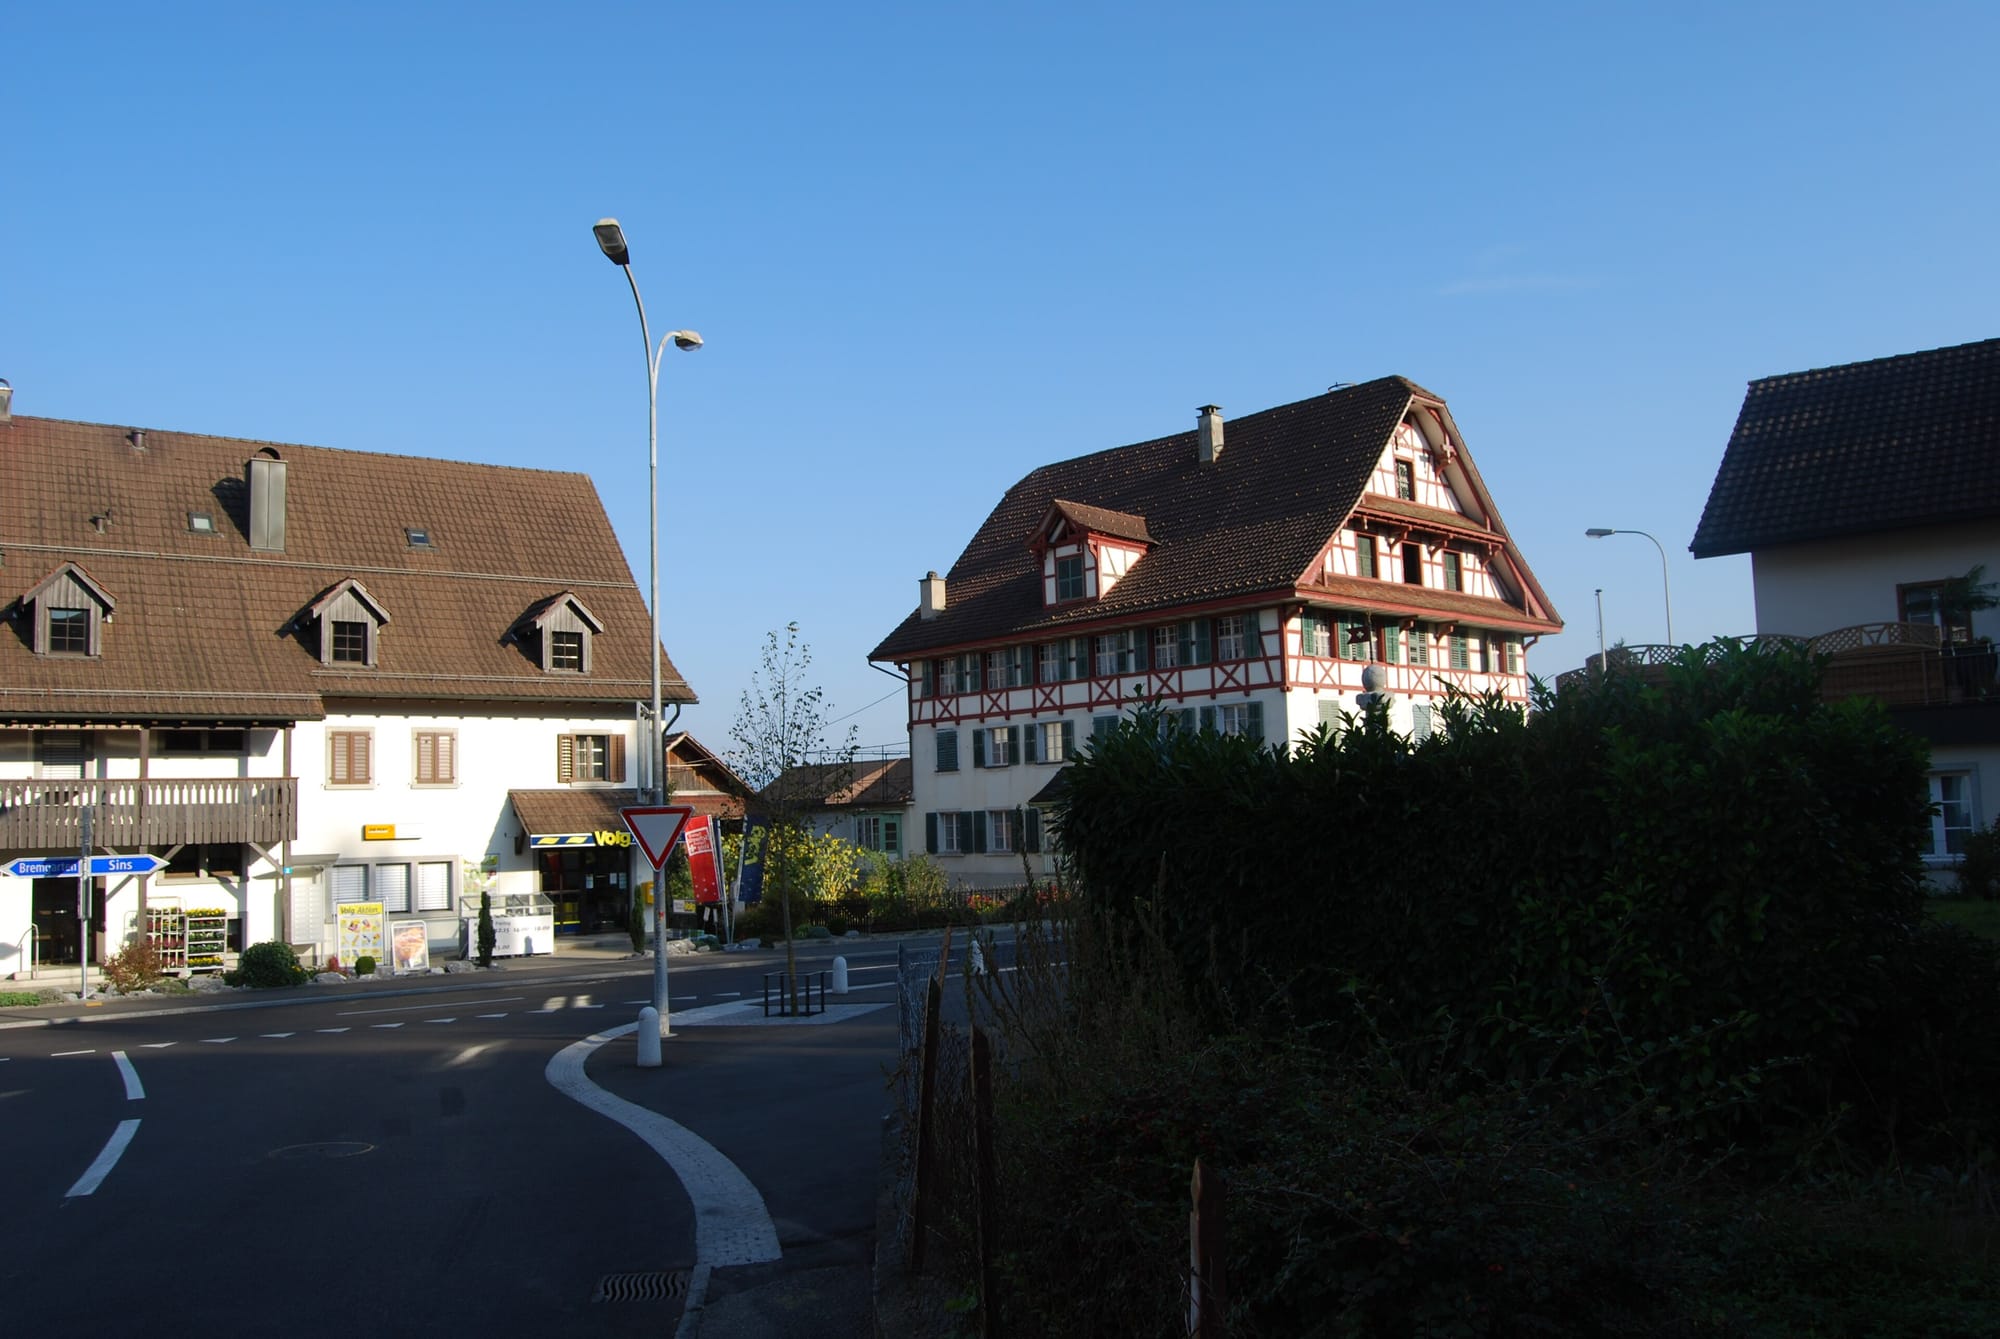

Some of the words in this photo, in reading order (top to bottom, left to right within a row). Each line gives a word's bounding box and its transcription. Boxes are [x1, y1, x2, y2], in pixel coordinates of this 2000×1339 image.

[594, 830, 631, 848] Volg
[19, 862, 77, 875] Bremgarten
[108, 859, 133, 871] Sins
